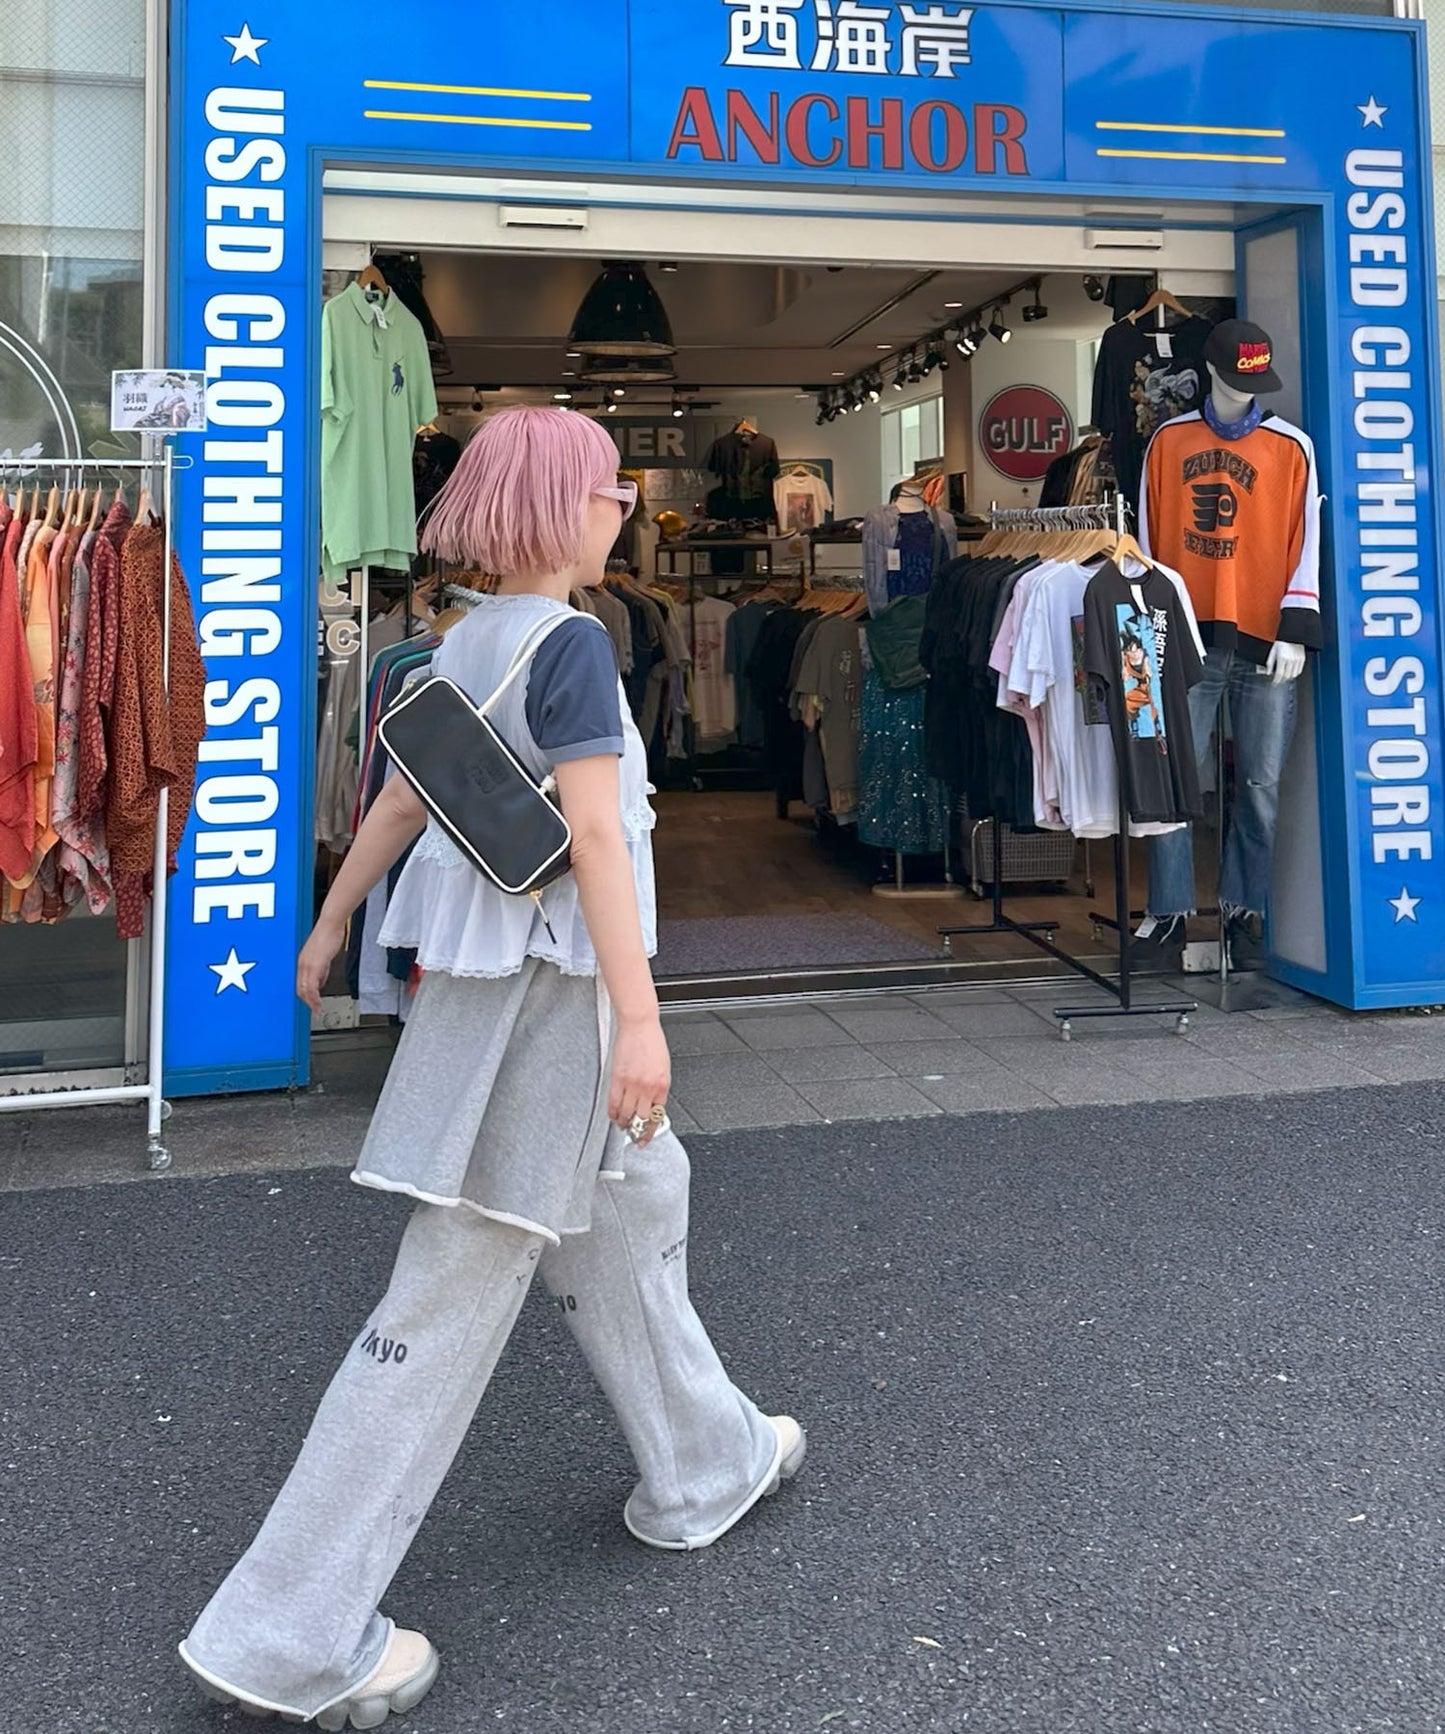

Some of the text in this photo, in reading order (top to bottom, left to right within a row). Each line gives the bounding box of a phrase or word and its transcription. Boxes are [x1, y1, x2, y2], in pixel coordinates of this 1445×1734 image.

[722, 0, 975, 79] 西海岸
[666, 86, 1030, 177] ANCHOR
[989, 416, 1067, 453] GULF
[193, 86, 286, 924] USED CLOTHING STORE
[1345, 148, 1429, 863] USED CLOTHING STORE
[361, 1326, 408, 1364] kyo
